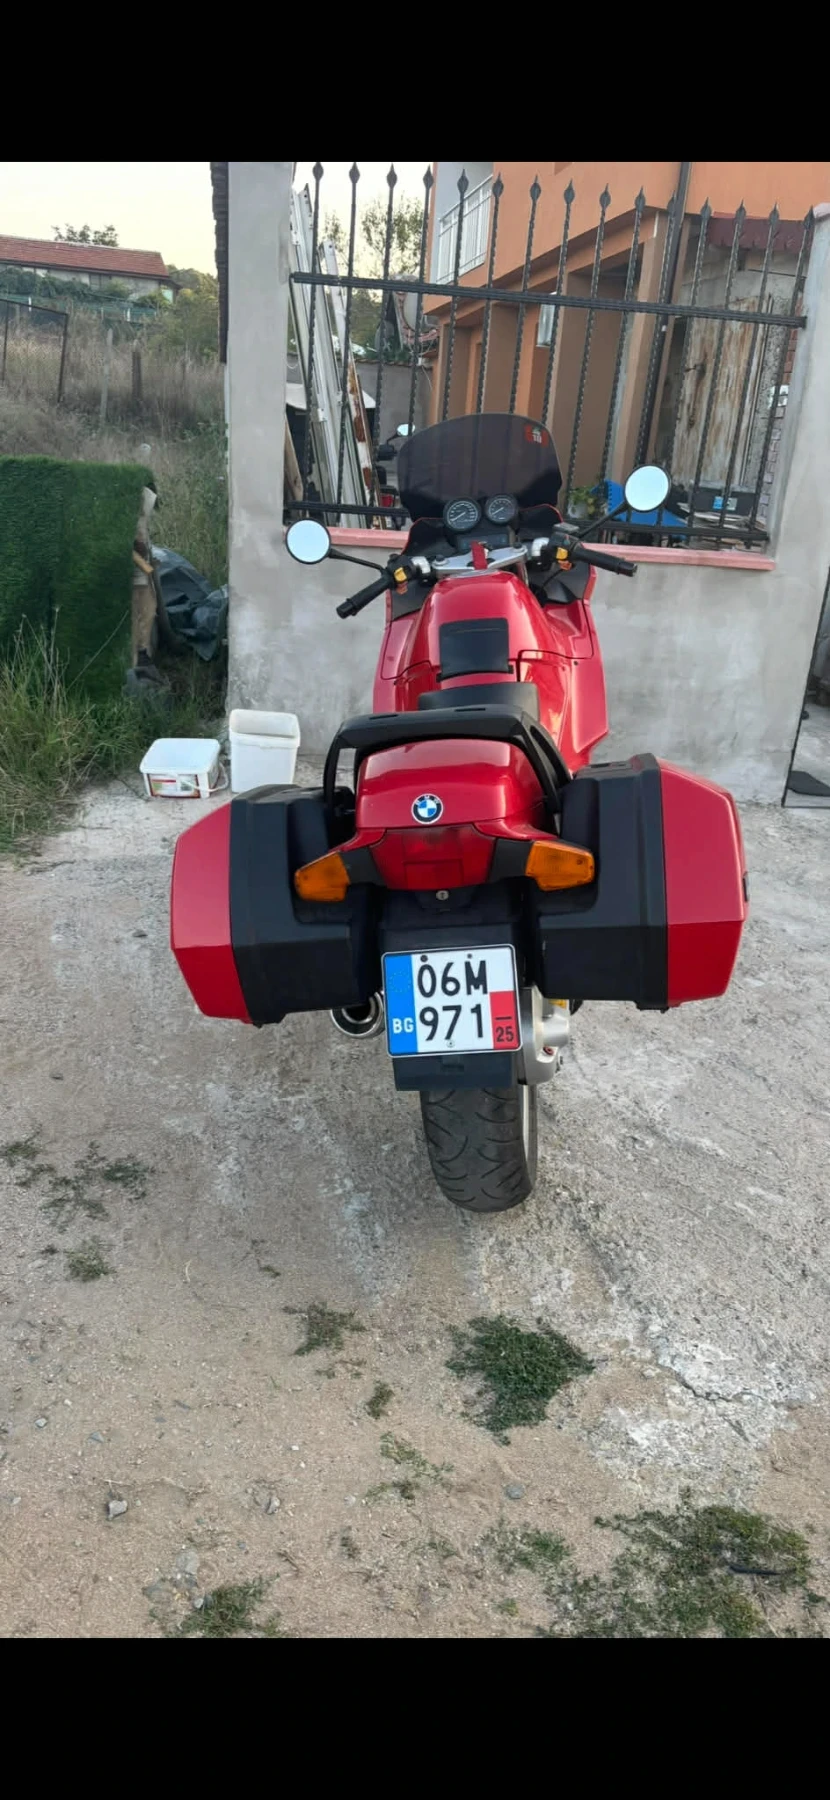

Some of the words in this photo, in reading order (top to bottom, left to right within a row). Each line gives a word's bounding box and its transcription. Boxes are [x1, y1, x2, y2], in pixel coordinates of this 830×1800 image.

[417, 960, 488, 998] 06M
[392, 1017, 414, 1034] BG
[420, 1003, 483, 1041] 971
[495, 1026, 514, 1042] 25
